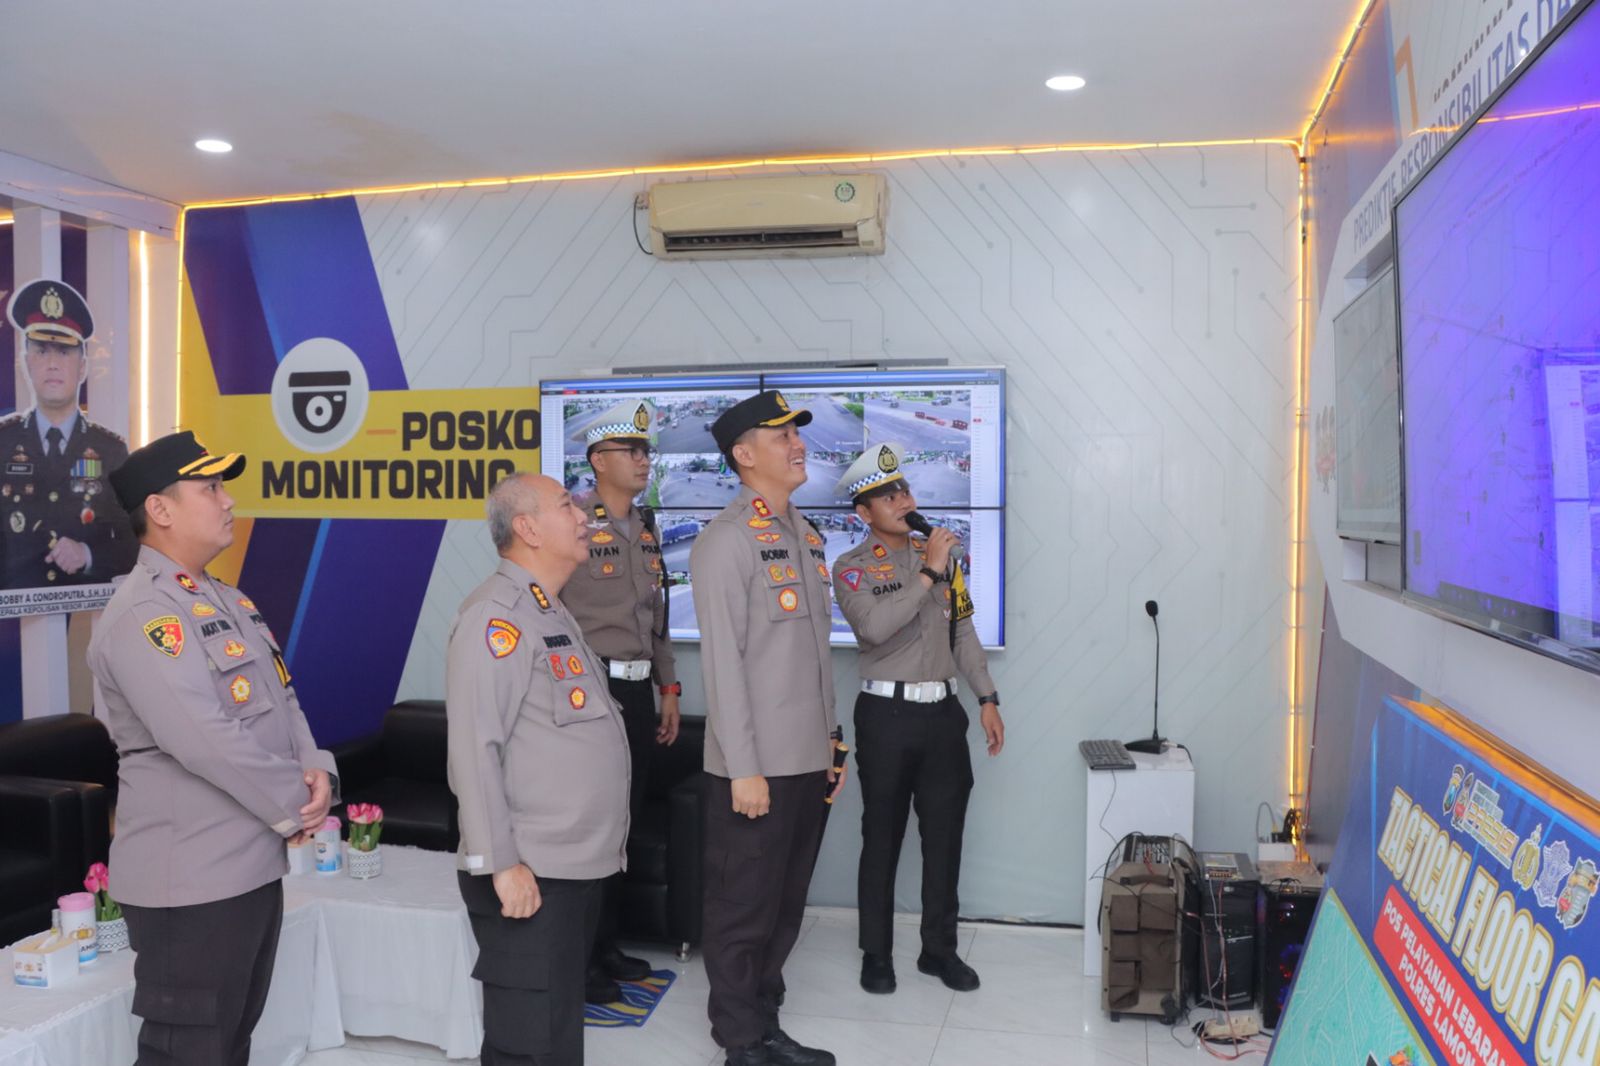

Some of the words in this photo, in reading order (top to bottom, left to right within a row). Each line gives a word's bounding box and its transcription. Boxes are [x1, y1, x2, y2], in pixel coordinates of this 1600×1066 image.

[401, 408, 541, 451] POSKO
[589, 546, 620, 558] IVAN
[760, 549, 790, 561] BOBBY
[0, 608, 22, 616] EPALA
[25, 594, 31, 603] A
[1377, 785, 1473, 943] TACTICAL
[1452, 865, 1554, 1044] FLOOR
[1383, 898, 1404, 933] POS
[1400, 922, 1455, 1009] PELAYANAN
[1398, 953, 1436, 1017] POLRES
